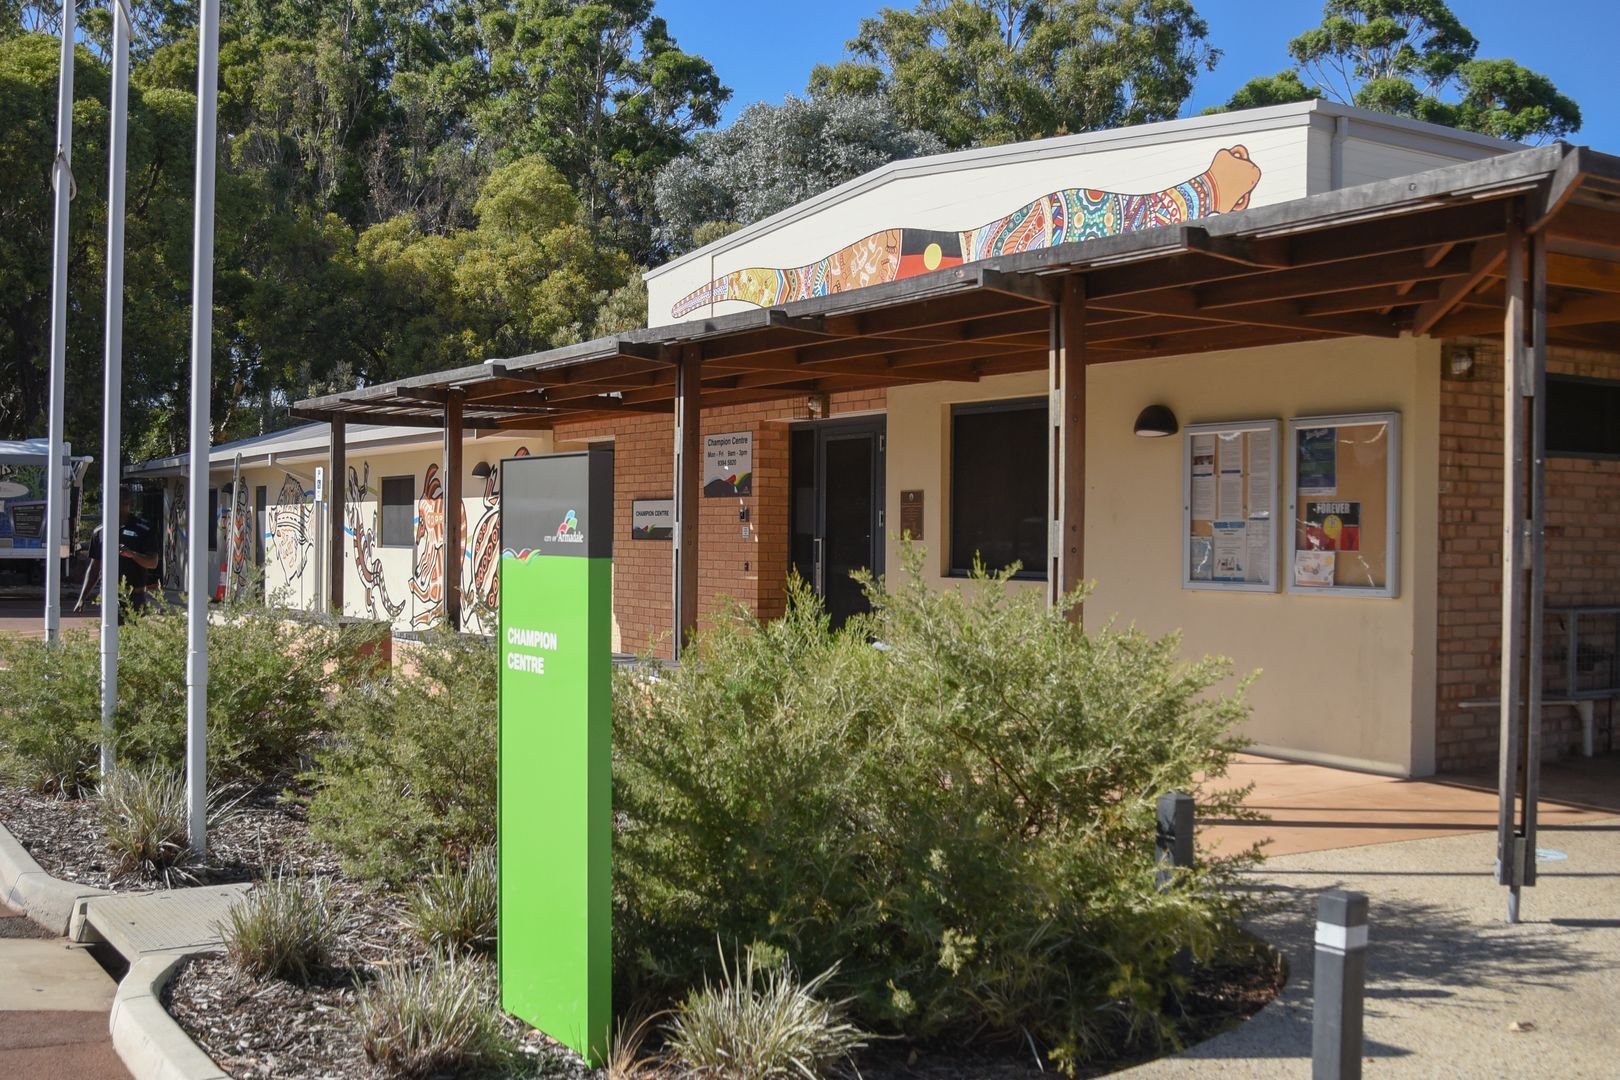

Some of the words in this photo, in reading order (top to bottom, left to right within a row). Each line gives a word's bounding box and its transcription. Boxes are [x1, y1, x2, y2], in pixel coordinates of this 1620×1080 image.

[708, 438, 731, 446] Champion
[1316, 503, 1350, 514] FOREVER
[558, 531, 584, 543] Armadale
[507, 627, 557, 650] CHAMPION
[507, 652, 544, 675] CENTRE
